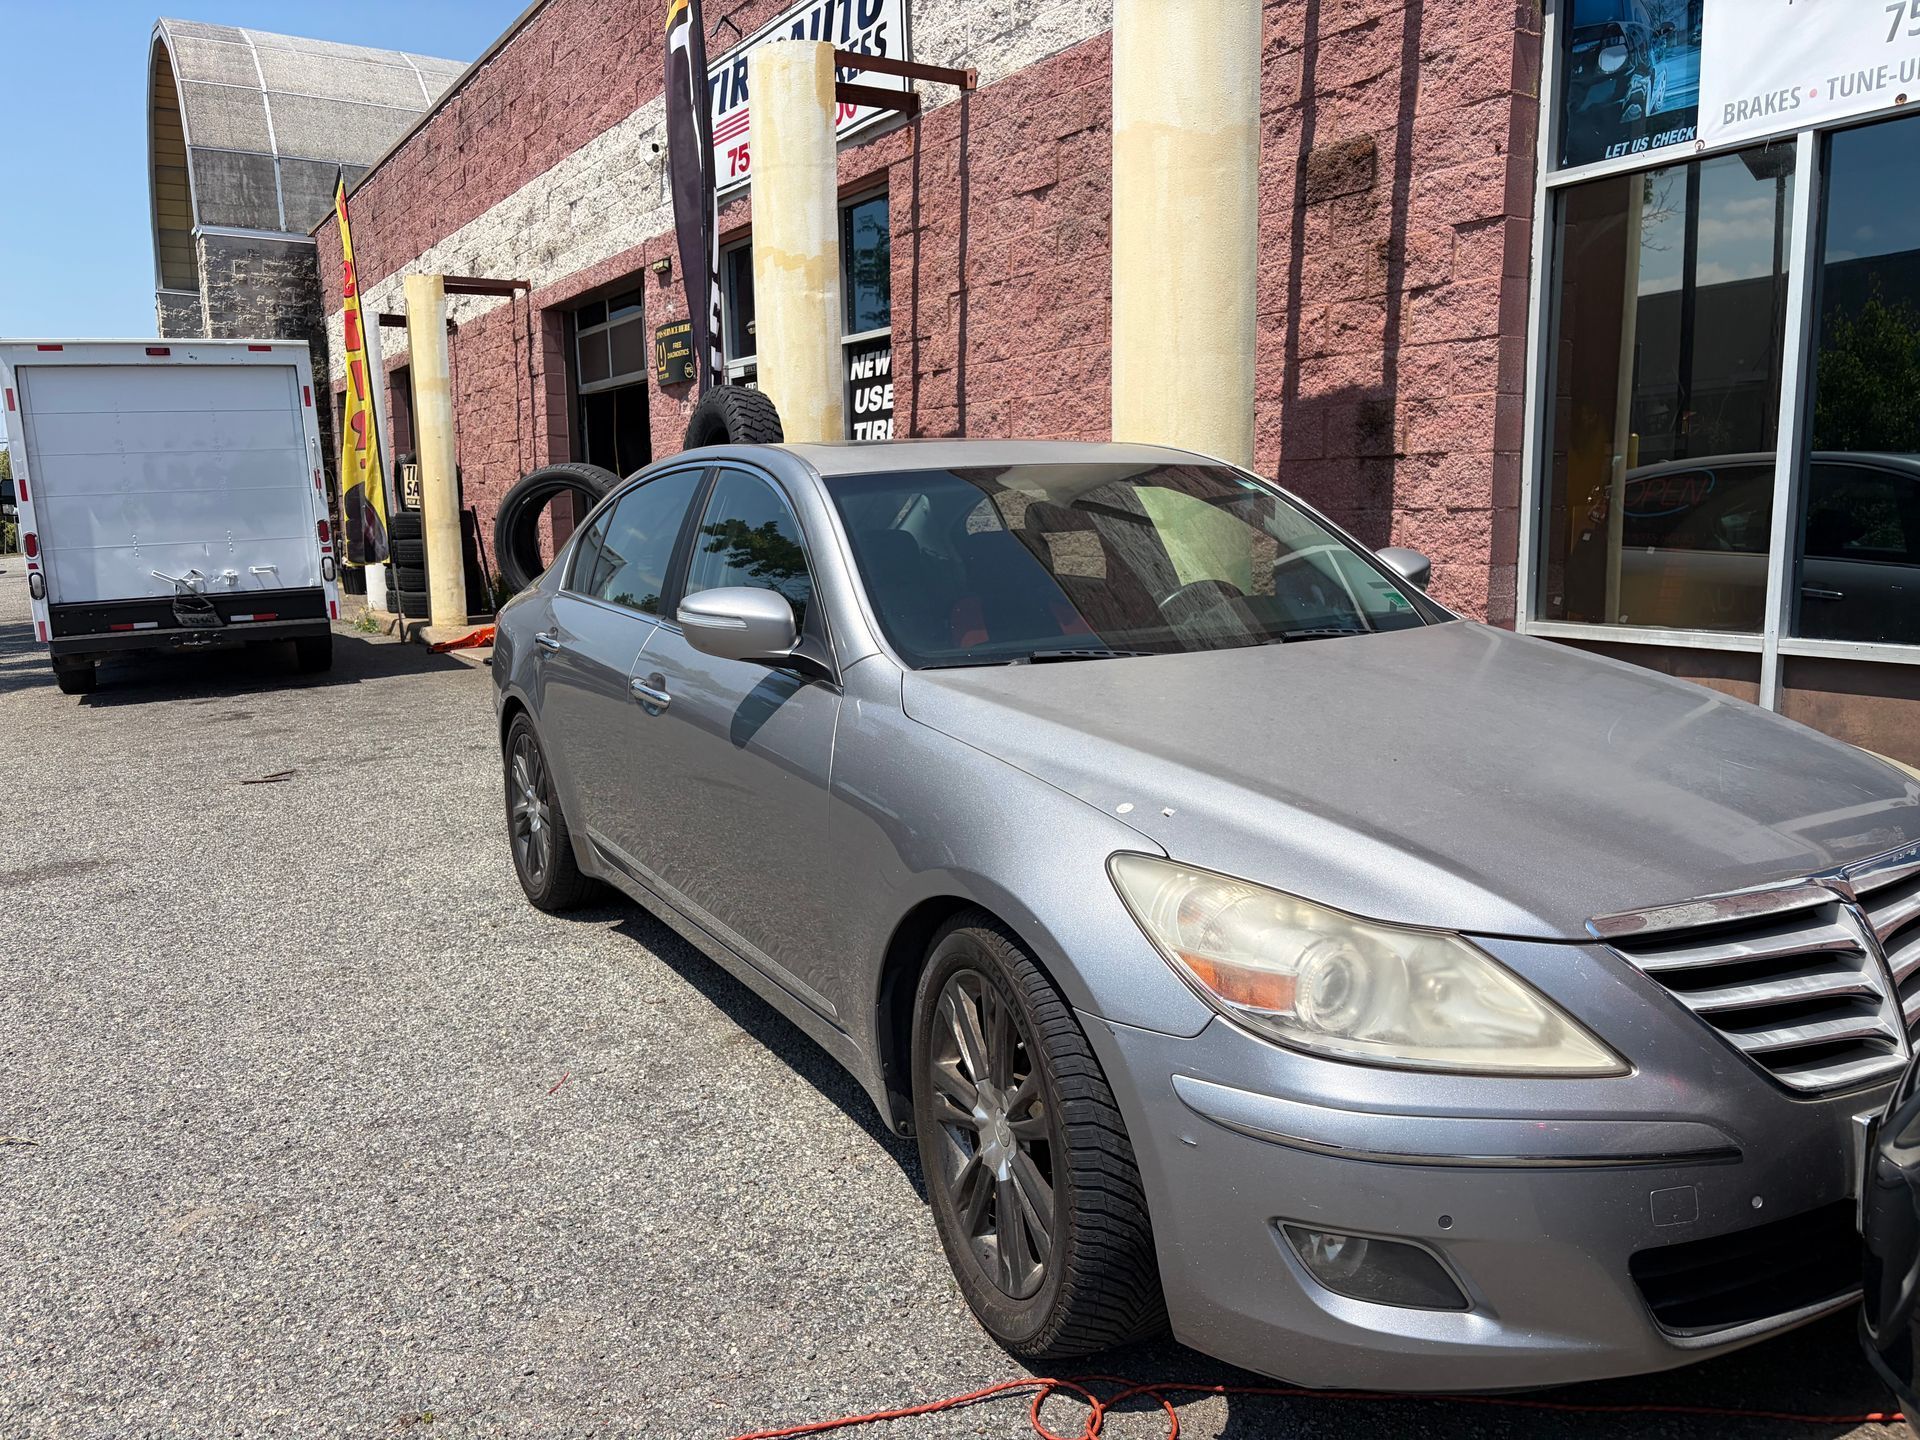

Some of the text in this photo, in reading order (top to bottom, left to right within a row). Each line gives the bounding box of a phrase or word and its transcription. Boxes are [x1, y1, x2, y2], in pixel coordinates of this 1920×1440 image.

[708, 55, 750, 116] TIR
[1722, 86, 1801, 125] BRAKES
[1605, 125, 1697, 159] LET US CHECK
[672, 341, 682, 349] FREE
[850, 348, 892, 381] NEW
[1625, 477, 1709, 509] OPEN
